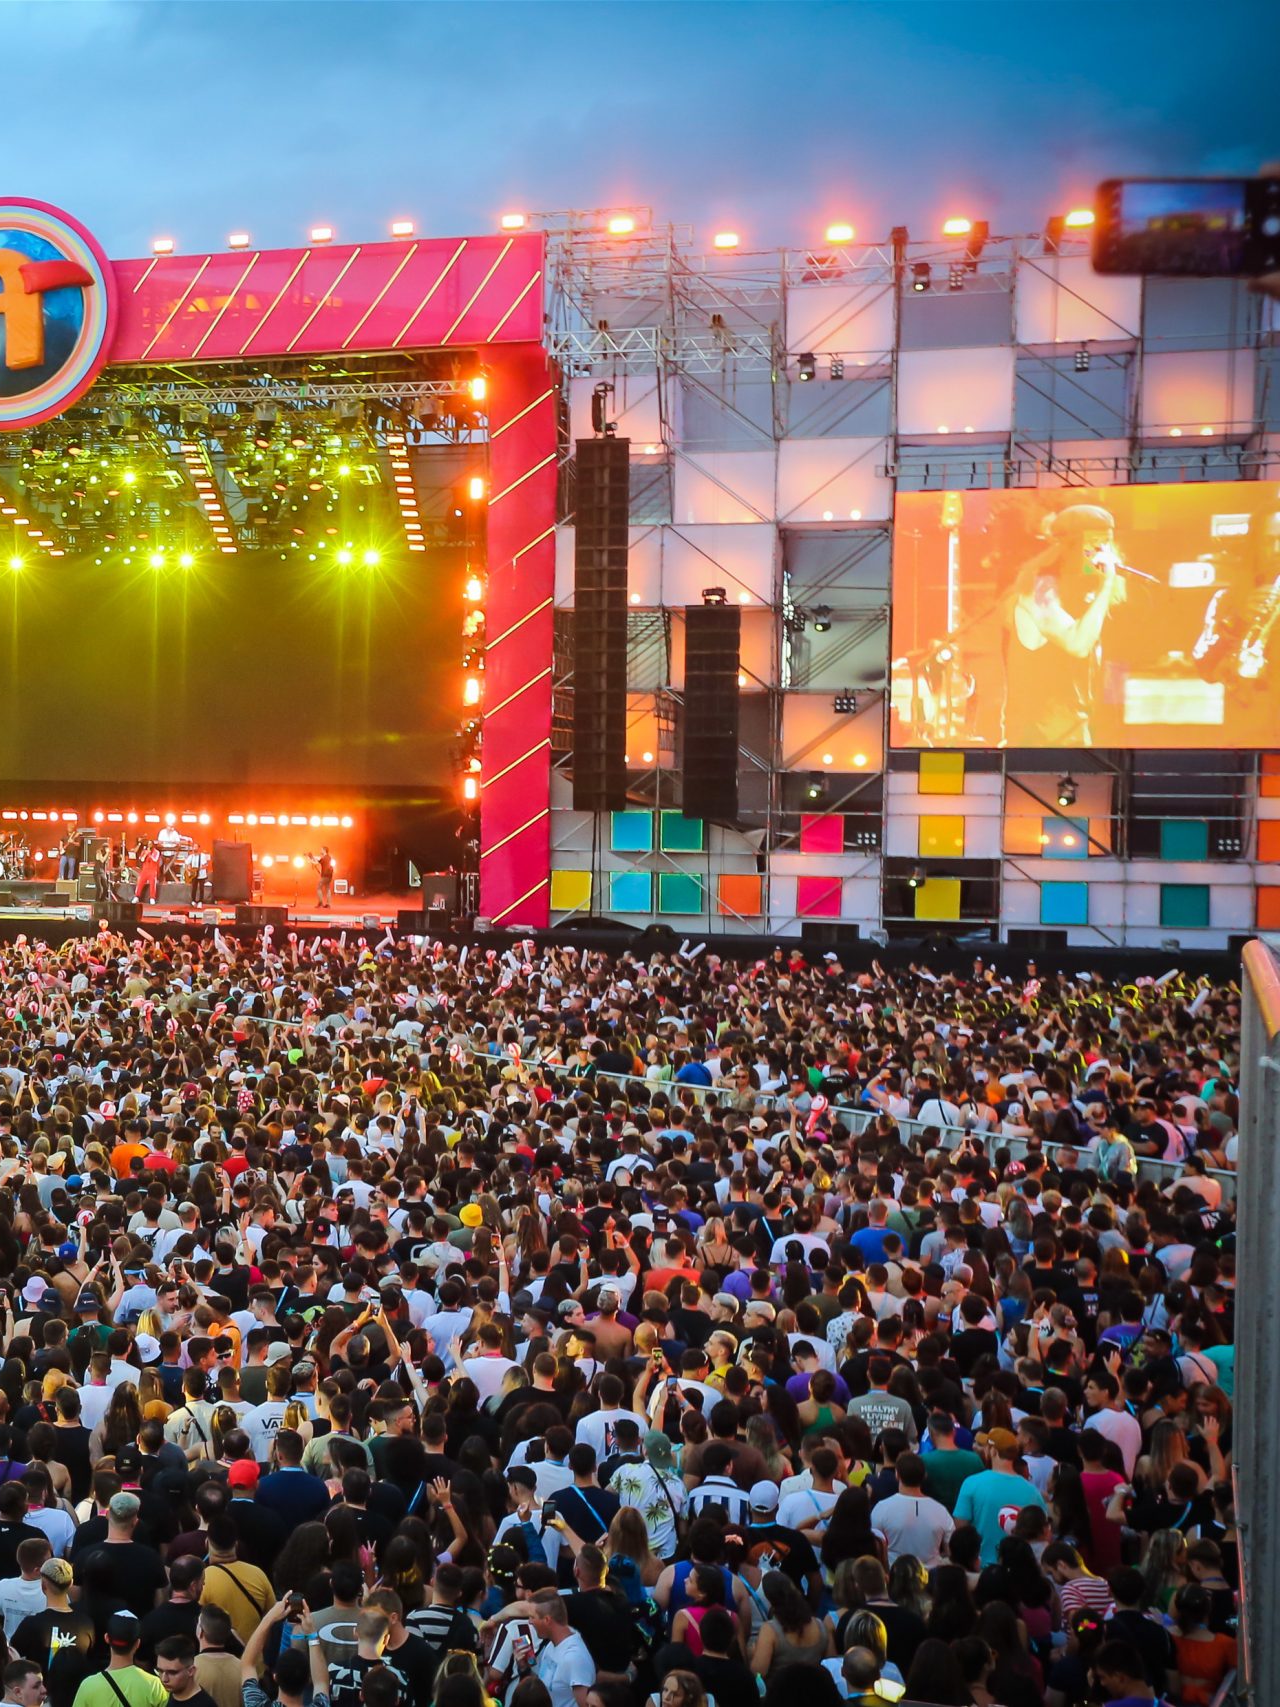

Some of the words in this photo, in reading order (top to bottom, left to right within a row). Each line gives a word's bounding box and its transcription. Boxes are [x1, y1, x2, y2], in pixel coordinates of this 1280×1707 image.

[861, 1405, 899, 1414] HEALTHY
[867, 1413, 895, 1421] LIVING
[261, 1418, 283, 1429] VA
